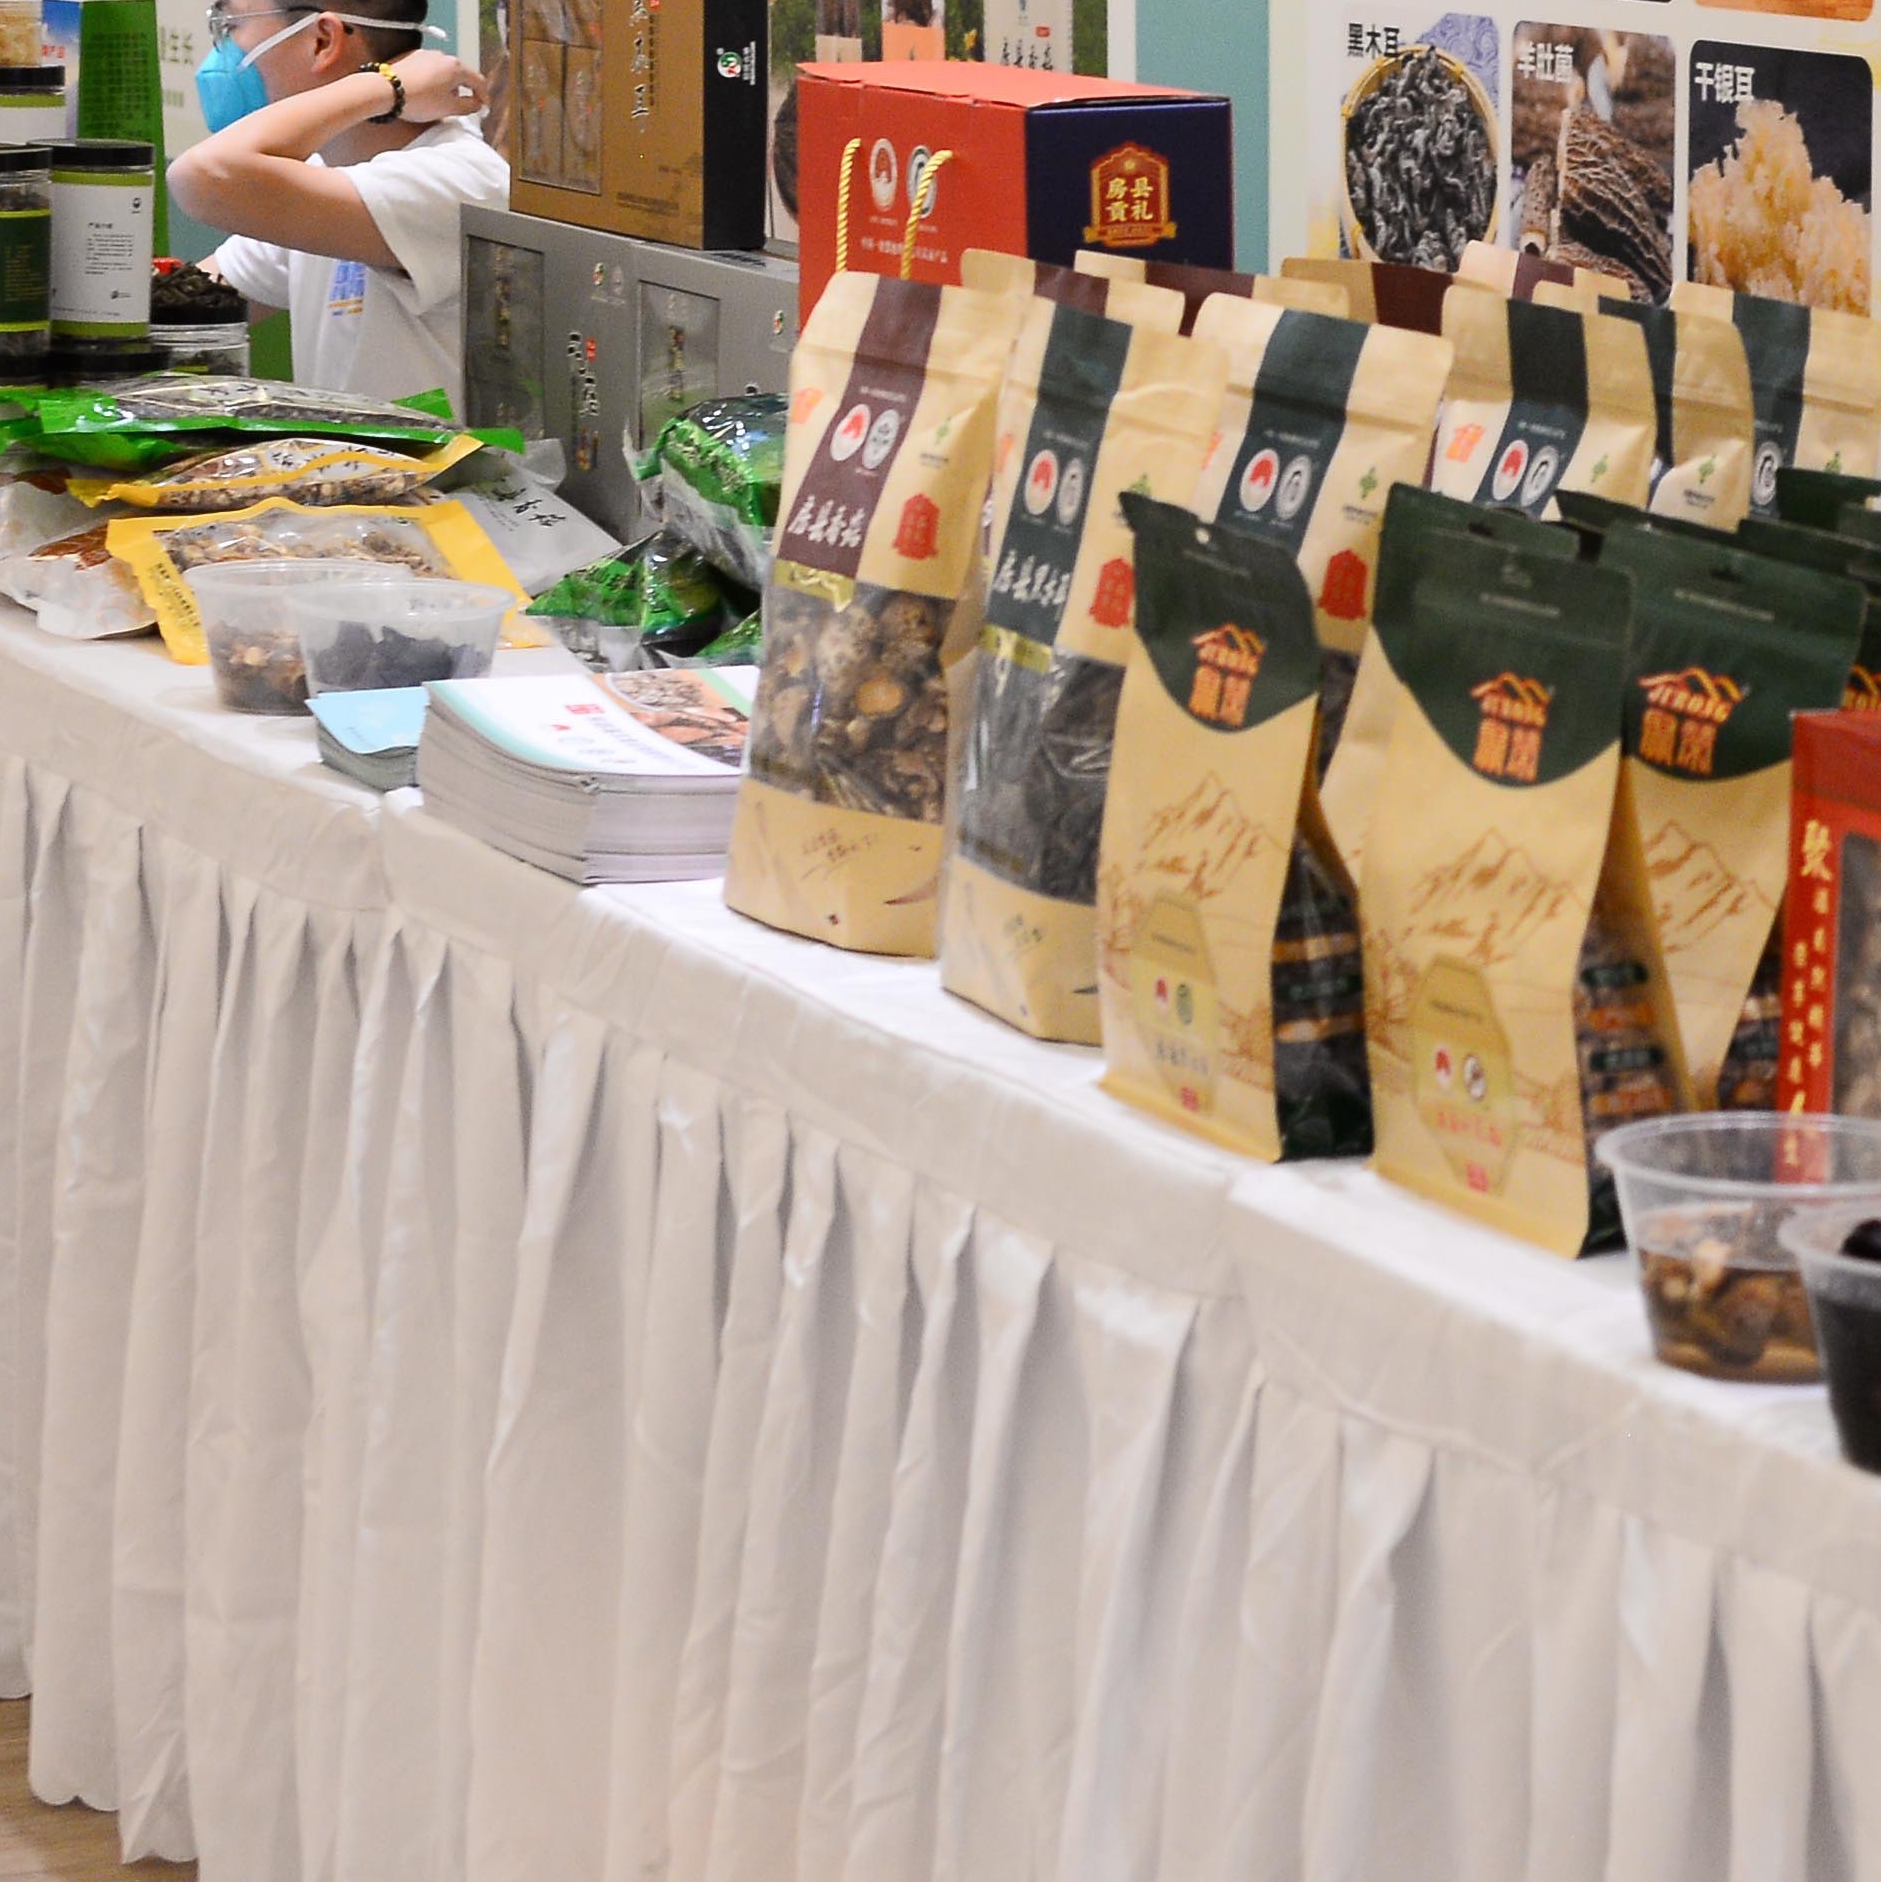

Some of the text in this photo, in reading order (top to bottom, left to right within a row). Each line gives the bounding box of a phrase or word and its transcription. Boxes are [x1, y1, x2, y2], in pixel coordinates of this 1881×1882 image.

[1345, 21, 1402, 59] 黑木耳
[1694, 60, 1756, 105] 干银耳
[1105, 176, 1155, 200] 房县
